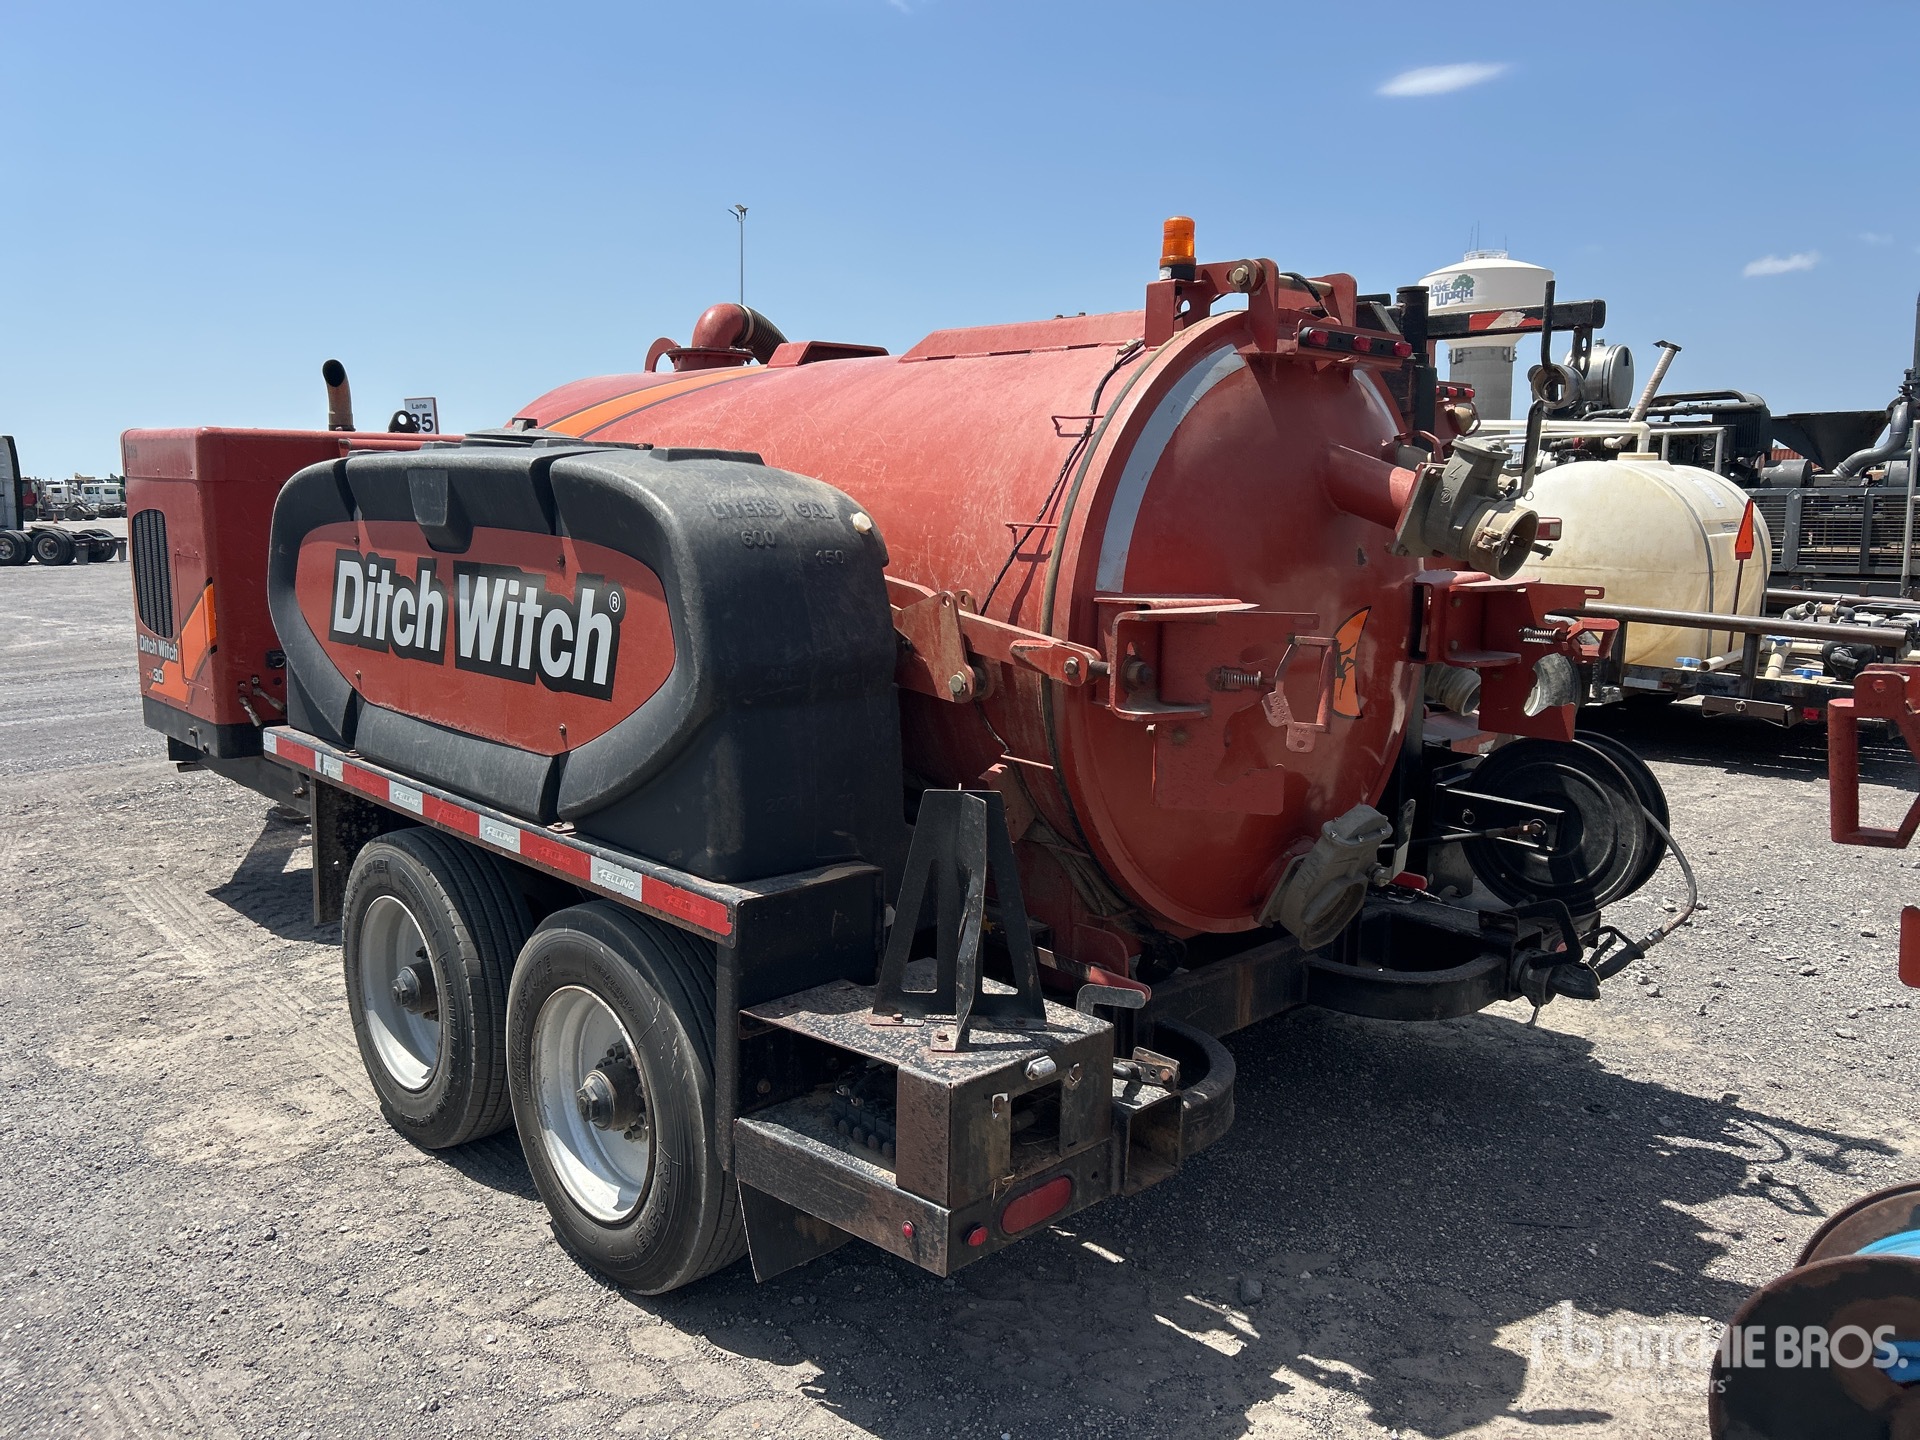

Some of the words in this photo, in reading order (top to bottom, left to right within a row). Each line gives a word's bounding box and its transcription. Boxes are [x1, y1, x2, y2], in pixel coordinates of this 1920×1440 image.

[1436, 289, 1474, 306] WORTH
[709, 499, 785, 521] LITERS
[792, 500, 835, 520] GAL
[740, 529, 777, 549] 600
[815, 549, 845, 565] 150
[333, 559, 445, 652] Ditch
[139, 634, 158, 655] Ditch
[158, 639, 178, 662] Witch
[485, 825, 516, 844] FELLING
[598, 869, 636, 892] FELLING
